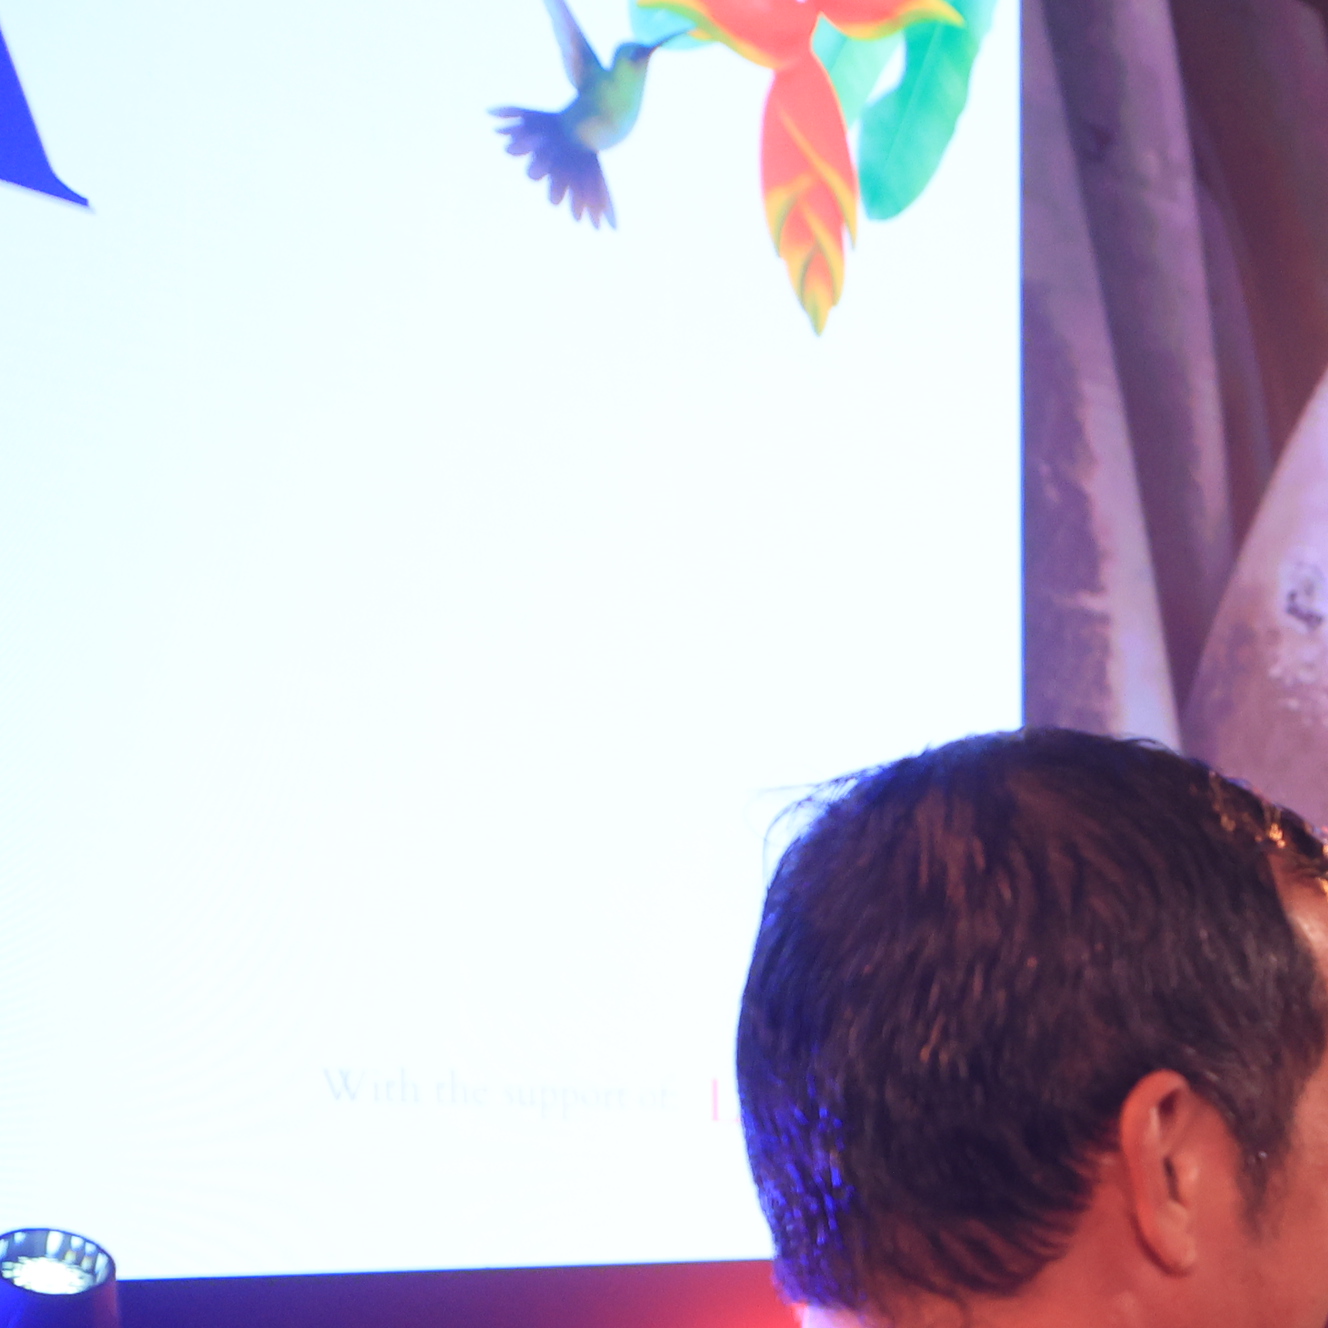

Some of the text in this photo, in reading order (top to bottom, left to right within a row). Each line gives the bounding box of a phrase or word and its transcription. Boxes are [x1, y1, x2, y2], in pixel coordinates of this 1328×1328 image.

[322, 1066, 421, 1104] With
[435, 1066, 489, 1107] the
[503, 1081, 629, 1121] support
